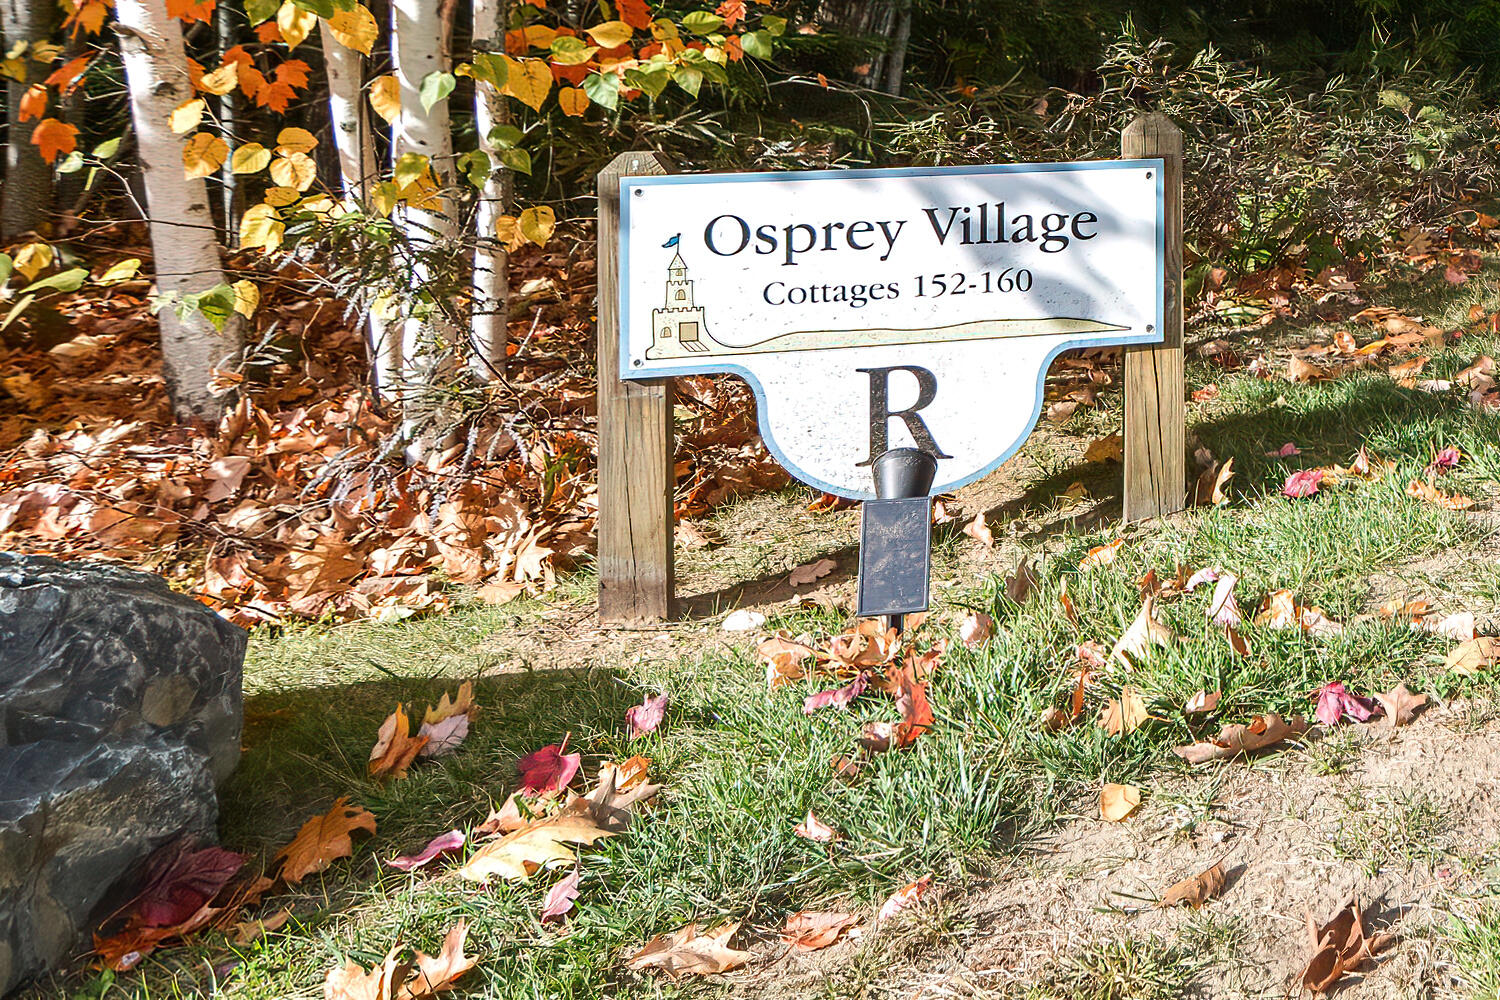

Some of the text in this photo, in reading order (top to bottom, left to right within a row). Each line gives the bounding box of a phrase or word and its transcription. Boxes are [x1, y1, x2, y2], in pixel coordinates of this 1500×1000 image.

[703, 202, 1099, 265] Osprey Village
[763, 268, 1034, 308] Cottages 152-160
[855, 365, 954, 467] R
